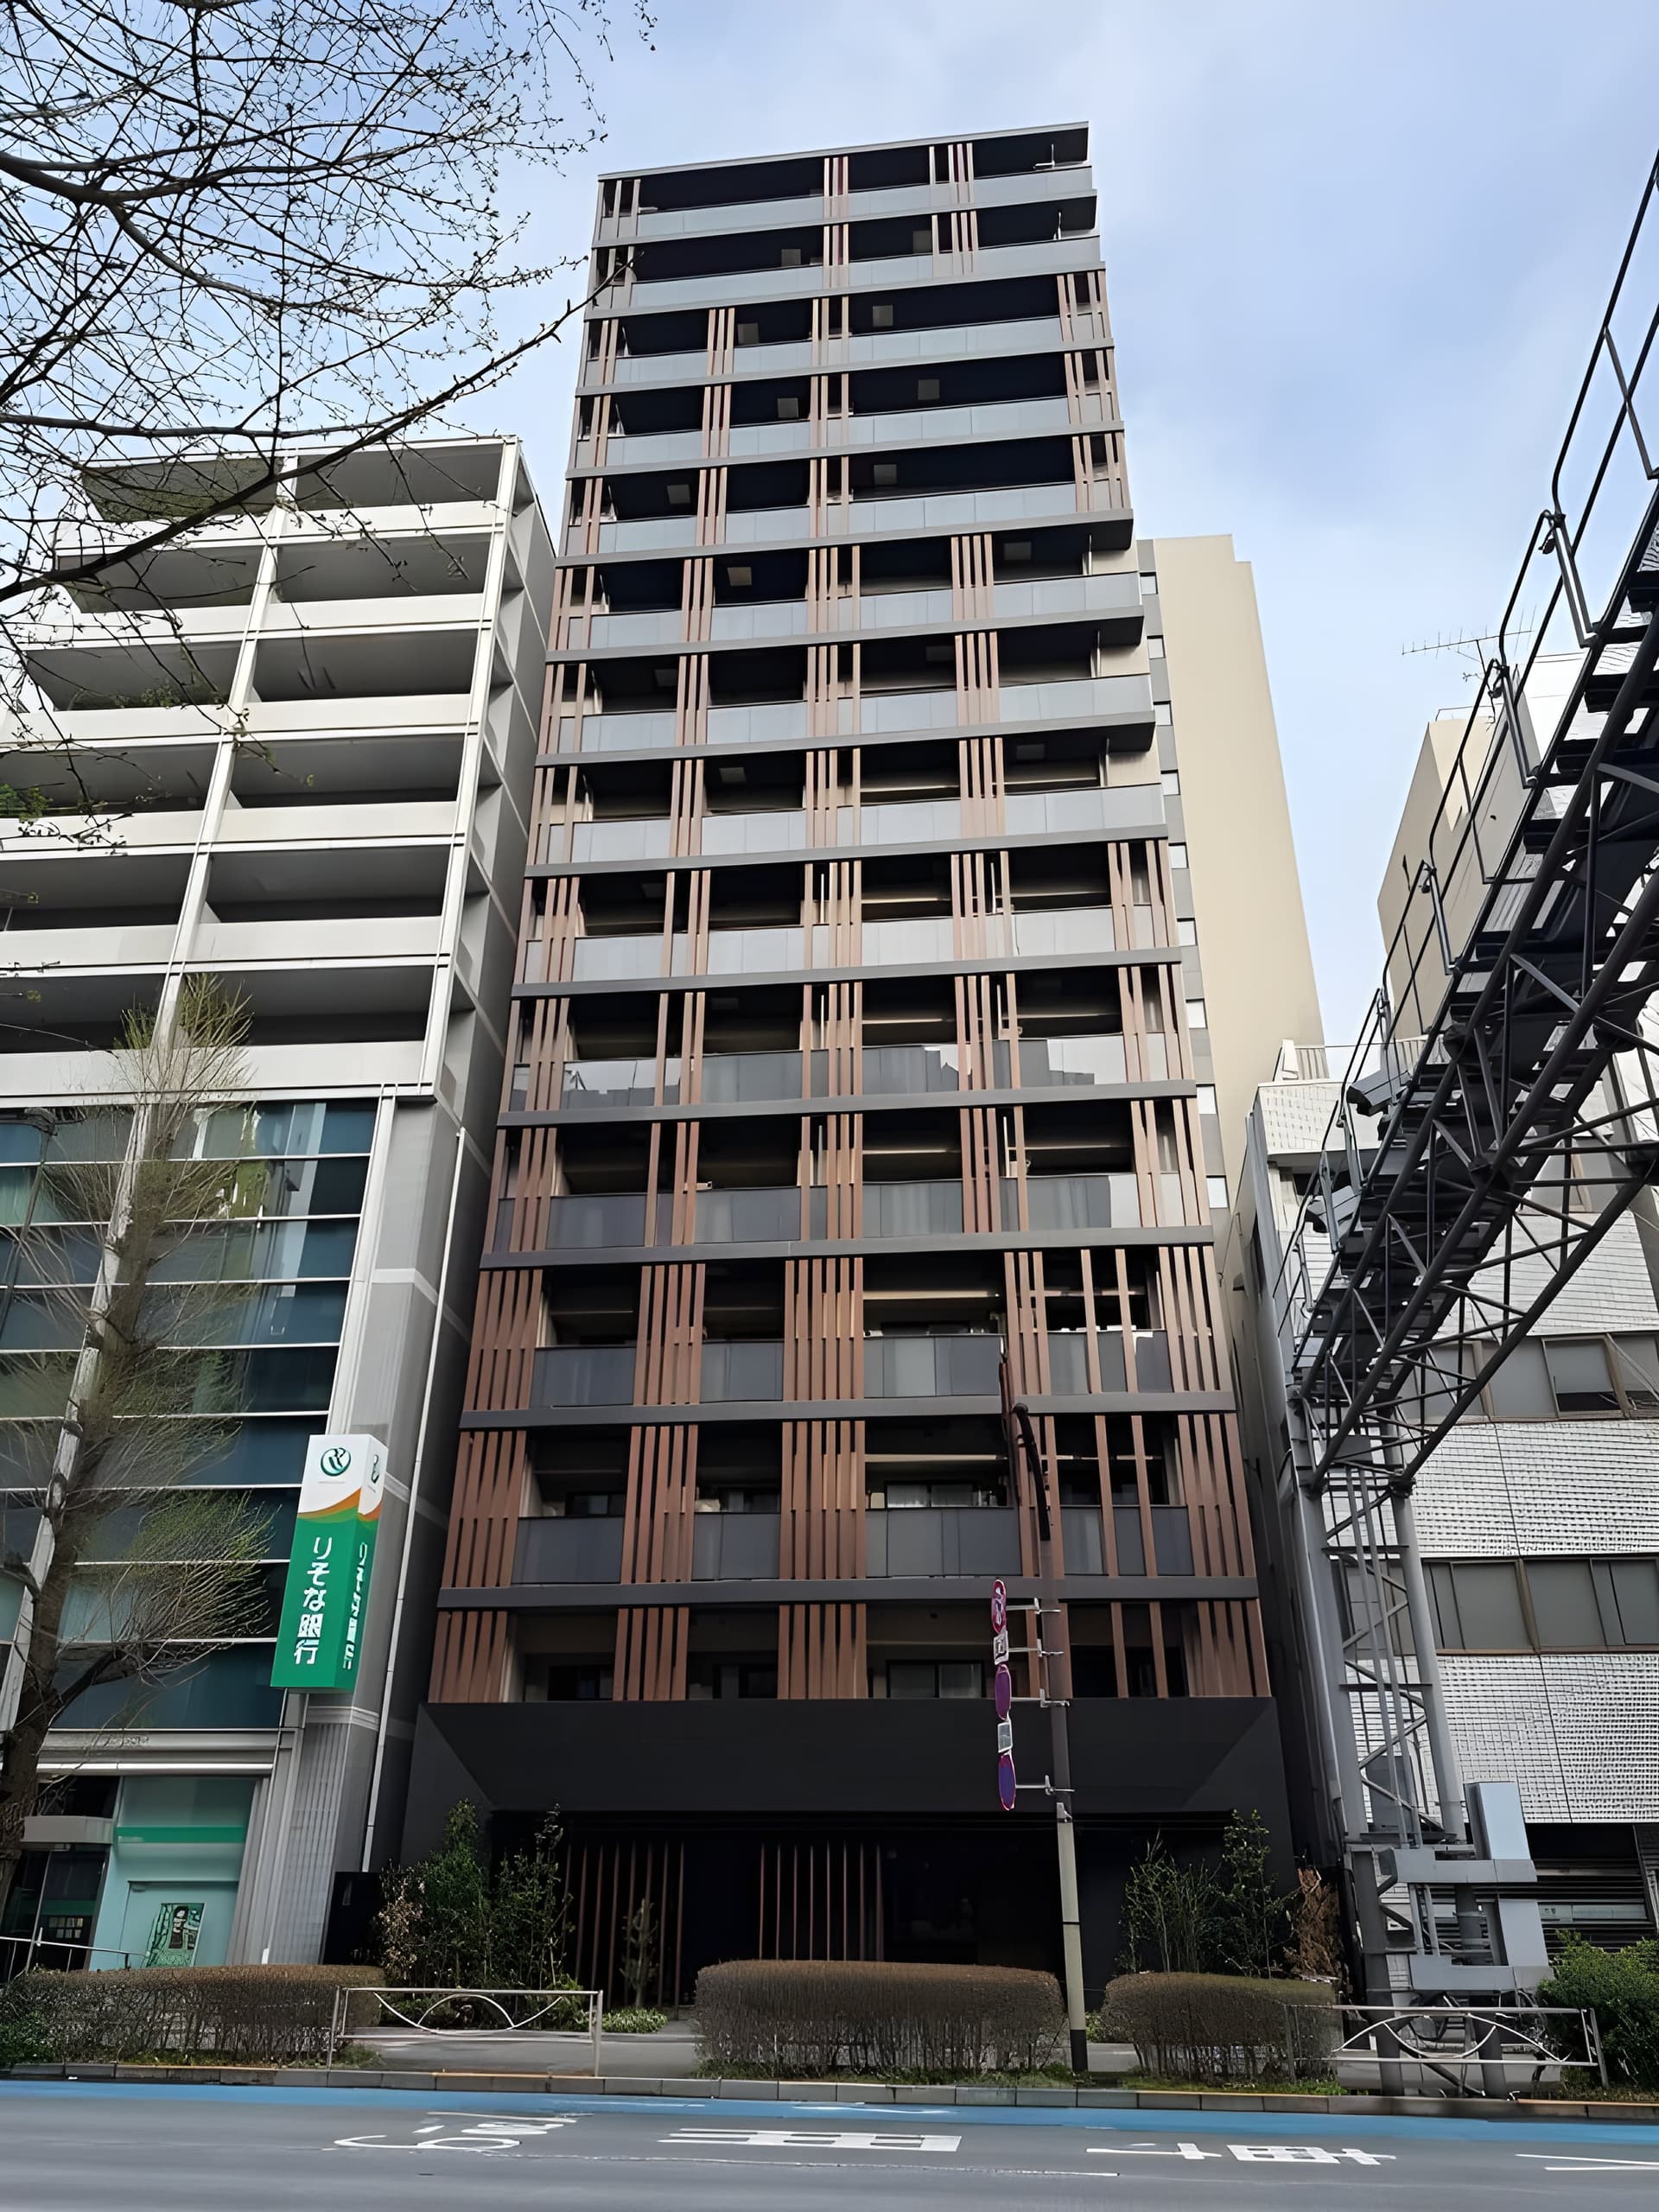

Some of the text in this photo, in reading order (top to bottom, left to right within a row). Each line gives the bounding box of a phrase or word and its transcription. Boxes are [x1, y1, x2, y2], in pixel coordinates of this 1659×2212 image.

[294, 1536, 333, 1665] りそな銀行
